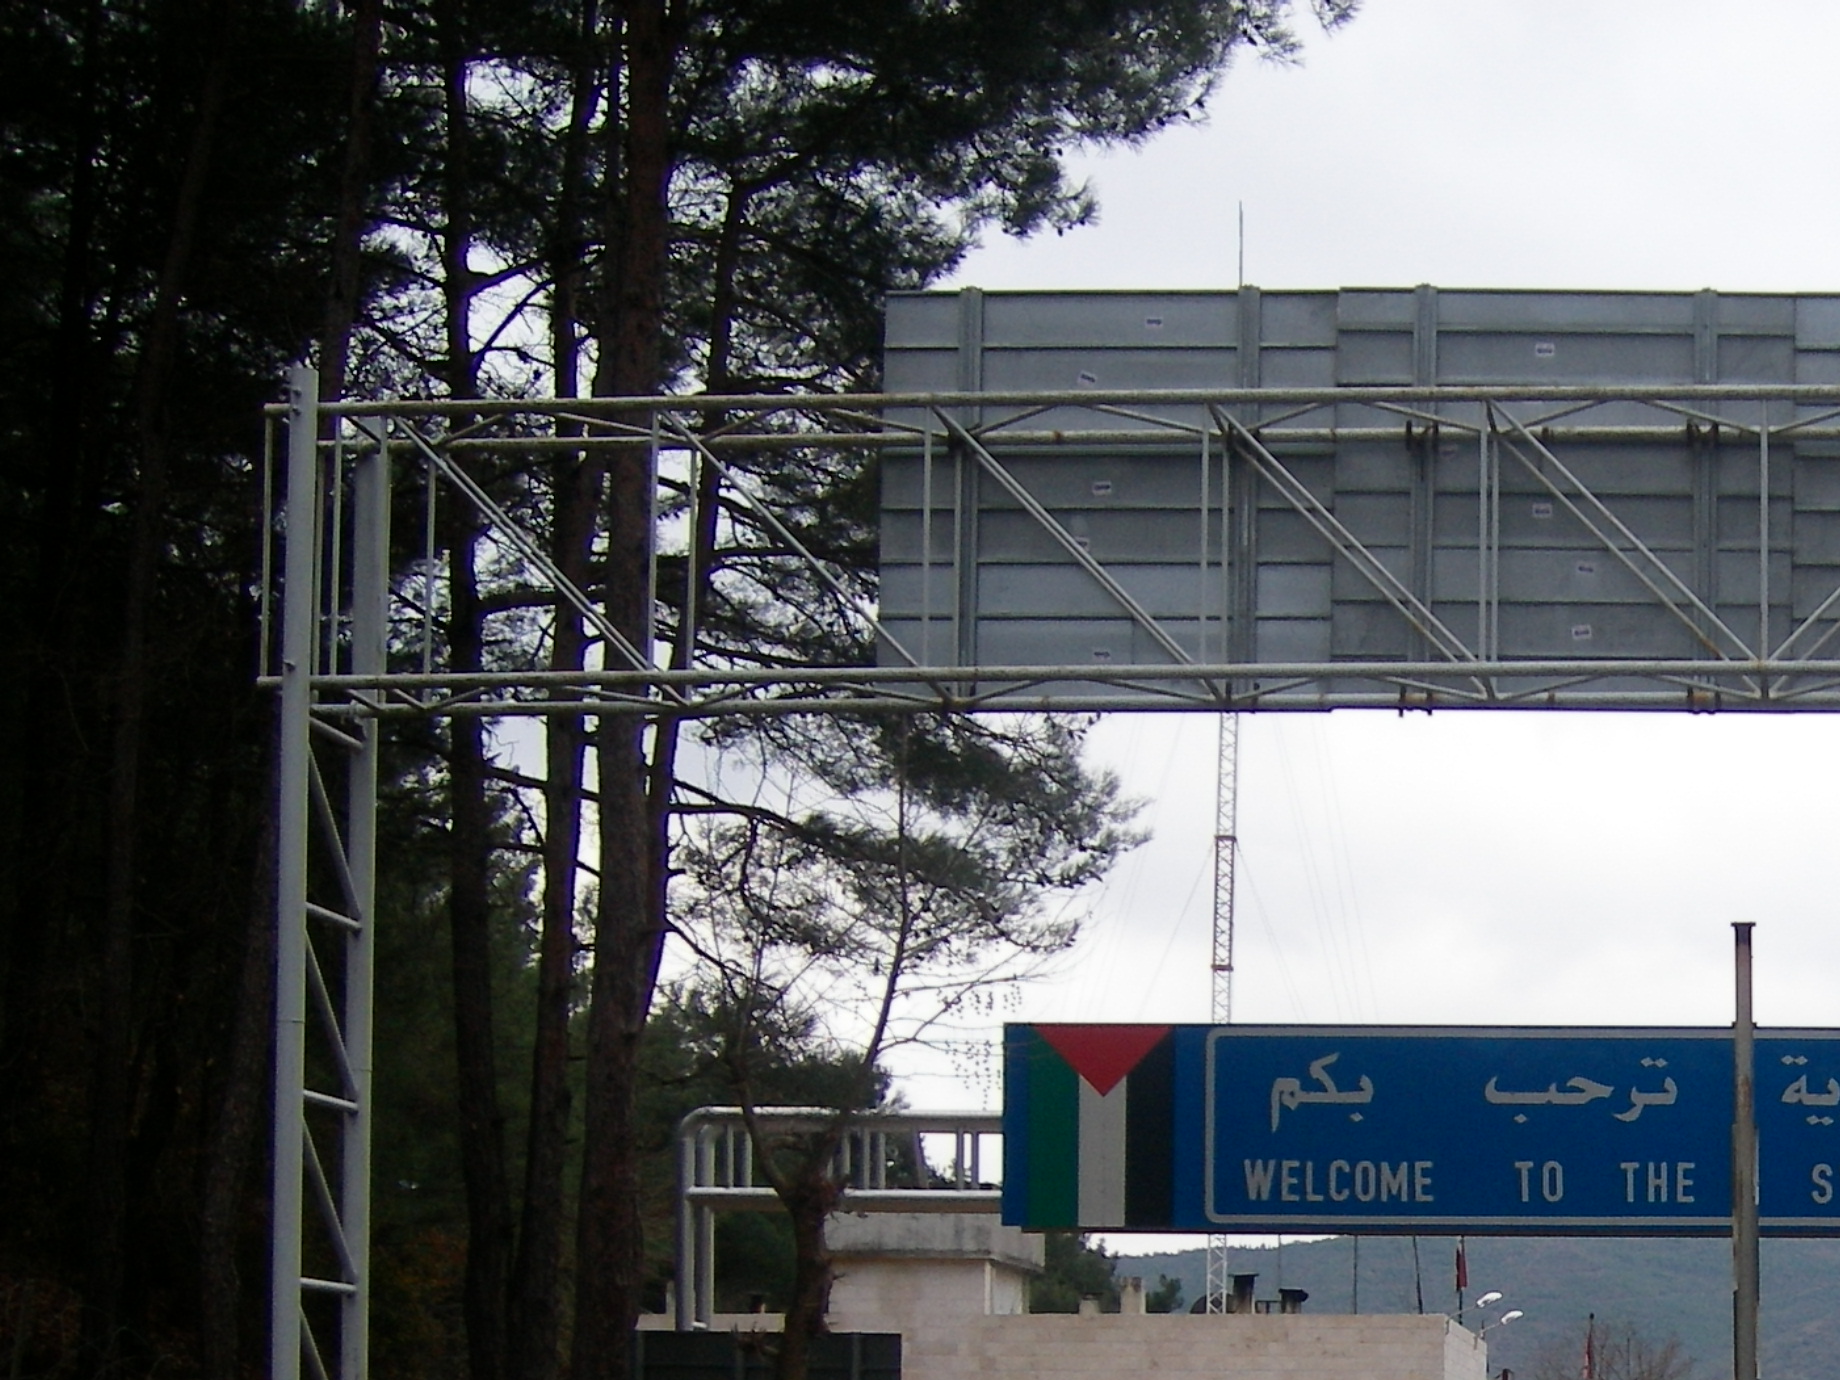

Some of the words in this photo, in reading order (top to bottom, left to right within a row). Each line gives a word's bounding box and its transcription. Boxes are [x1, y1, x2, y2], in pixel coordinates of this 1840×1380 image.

[1271, 1053, 1374, 1132] بكم
[1484, 1057, 1678, 1123] ترحب
[1244, 1159, 1434, 1202] WELCOME
[1514, 1160, 1564, 1202] TO
[1620, 1161, 1695, 1203] THE
